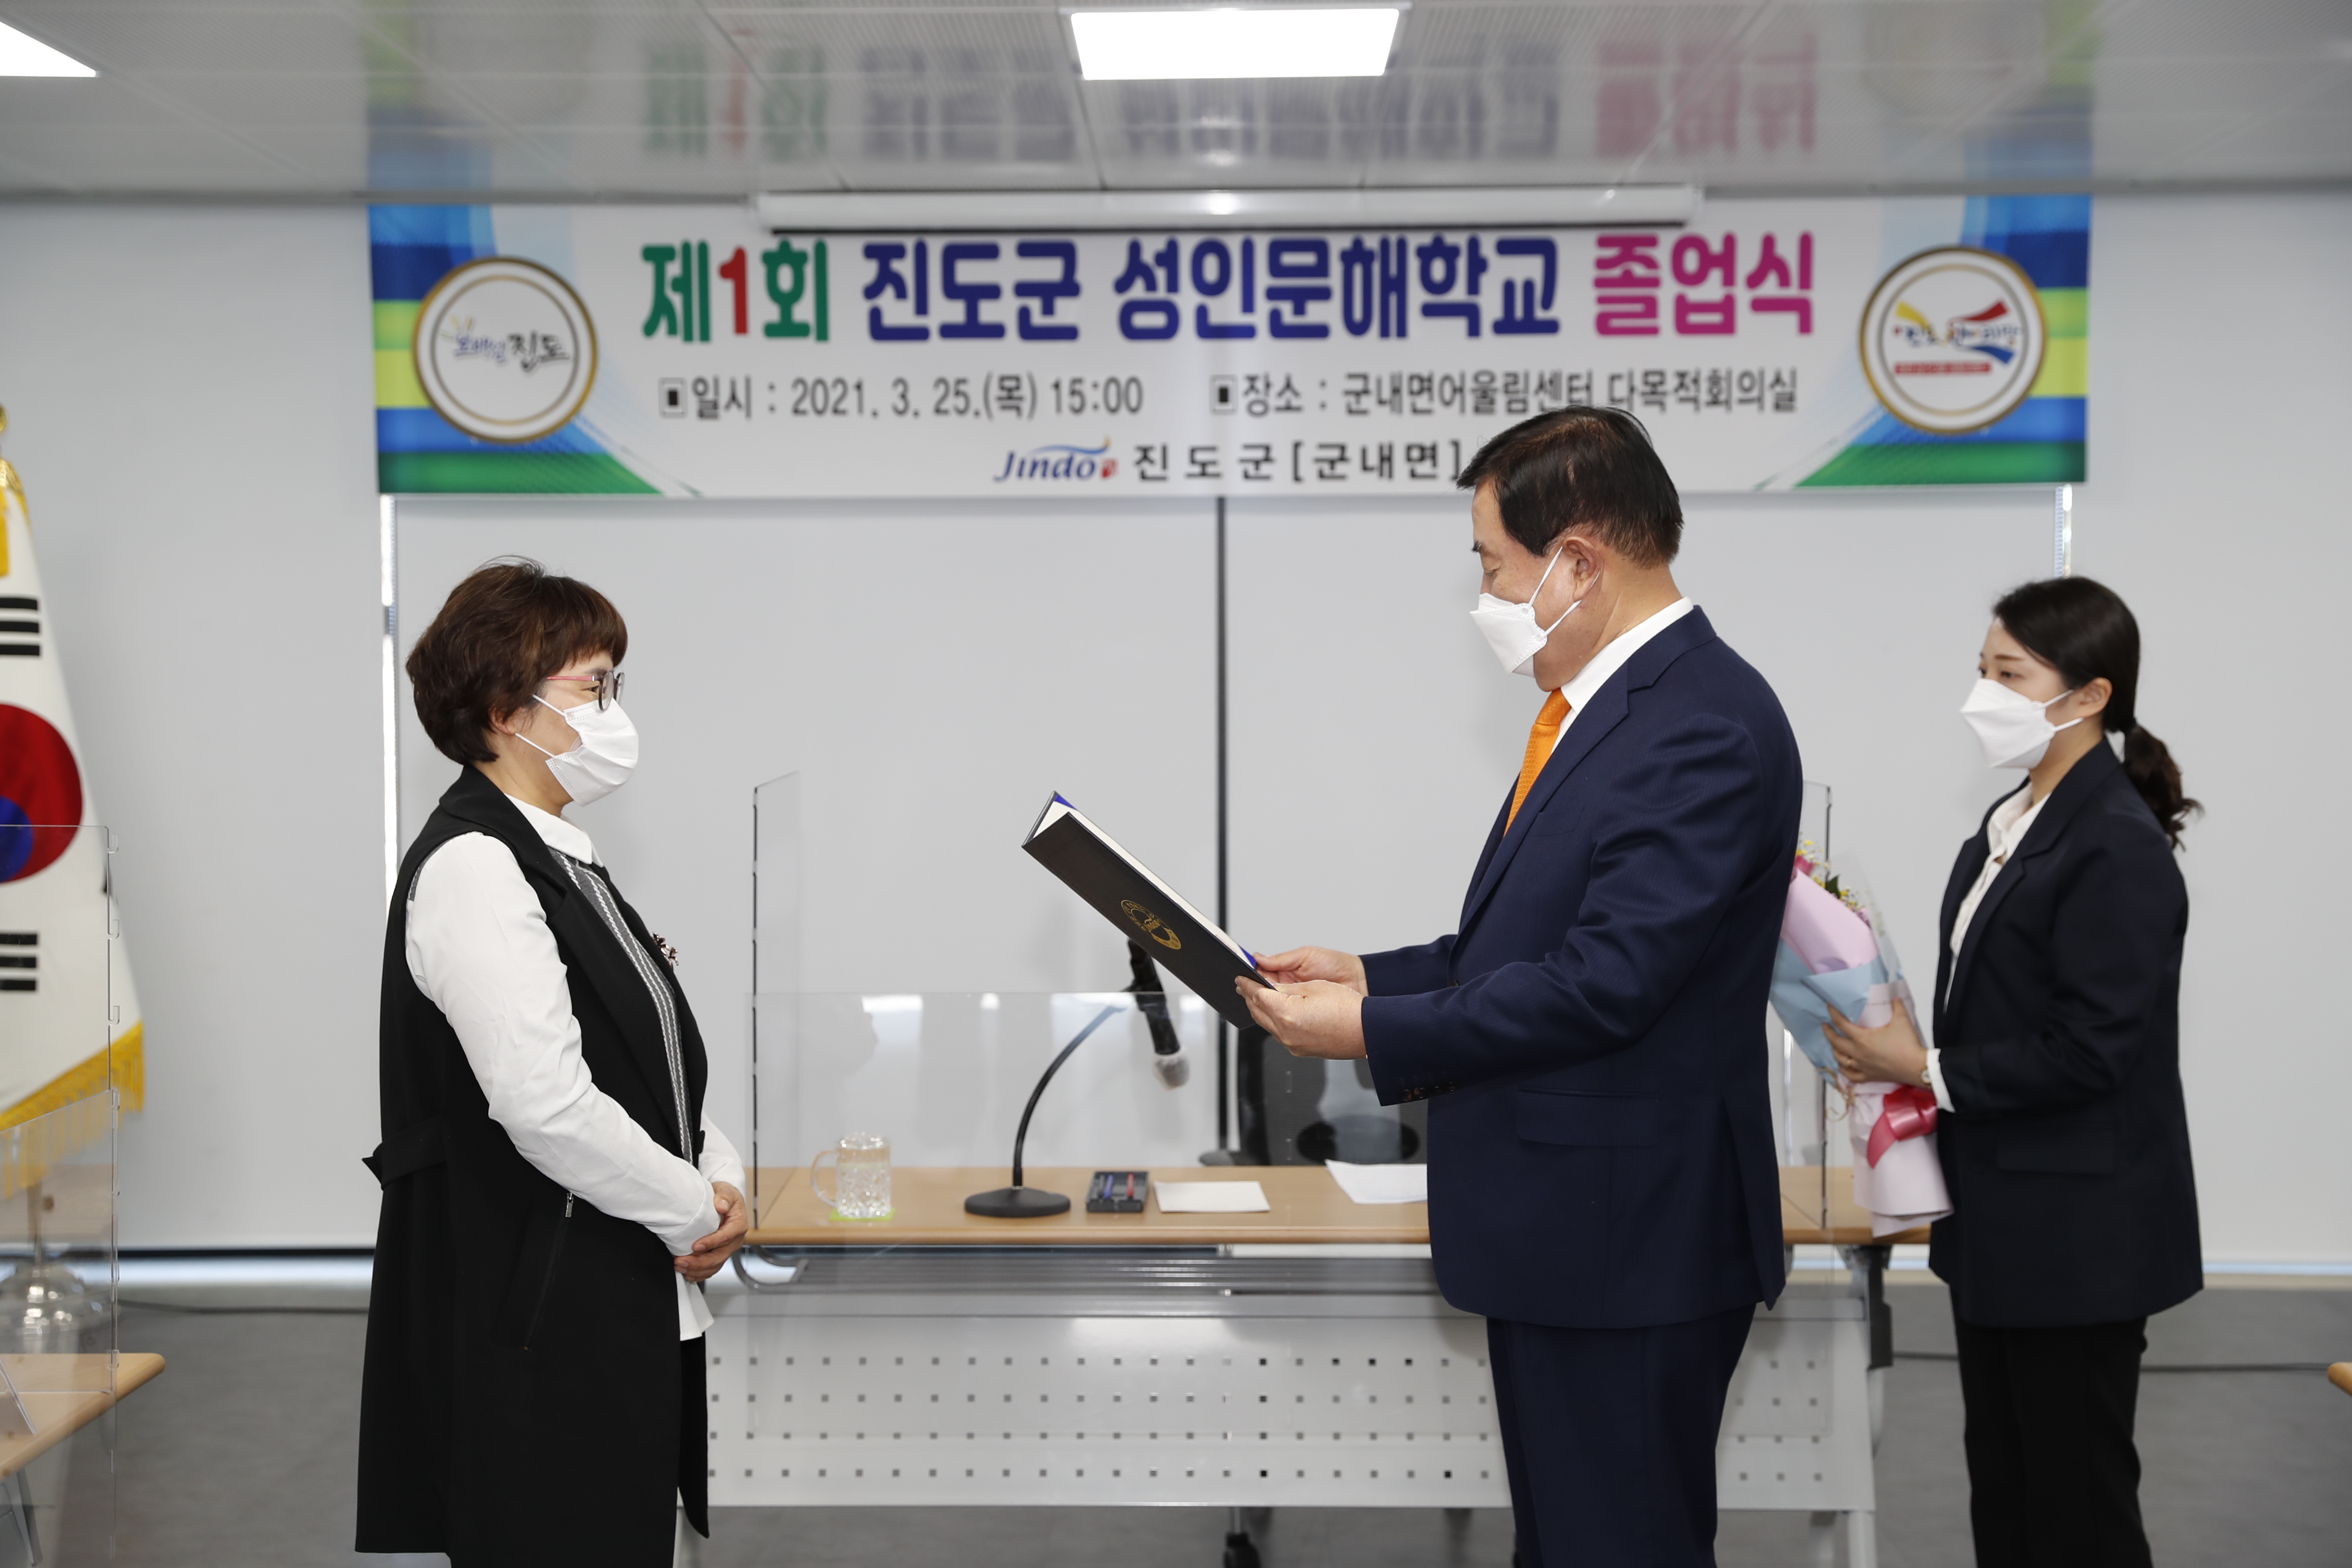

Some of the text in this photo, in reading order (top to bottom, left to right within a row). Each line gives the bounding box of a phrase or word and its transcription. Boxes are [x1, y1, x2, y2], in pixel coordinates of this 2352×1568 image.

[641, 231, 1814, 344] 제1회 진도군 성인문해학교 졸업식
[692, 376, 751, 420] 일시
[791, 377, 879, 418] 2021.
[892, 377, 920, 418] 3.
[1051, 375, 1144, 415] 15:00
[1244, 371, 1303, 418] 장소
[1343, 369, 1592, 416] 군내면어울림센터
[1608, 368, 1798, 413] 다목적회의실
[994, 449, 1097, 482] Jindo
